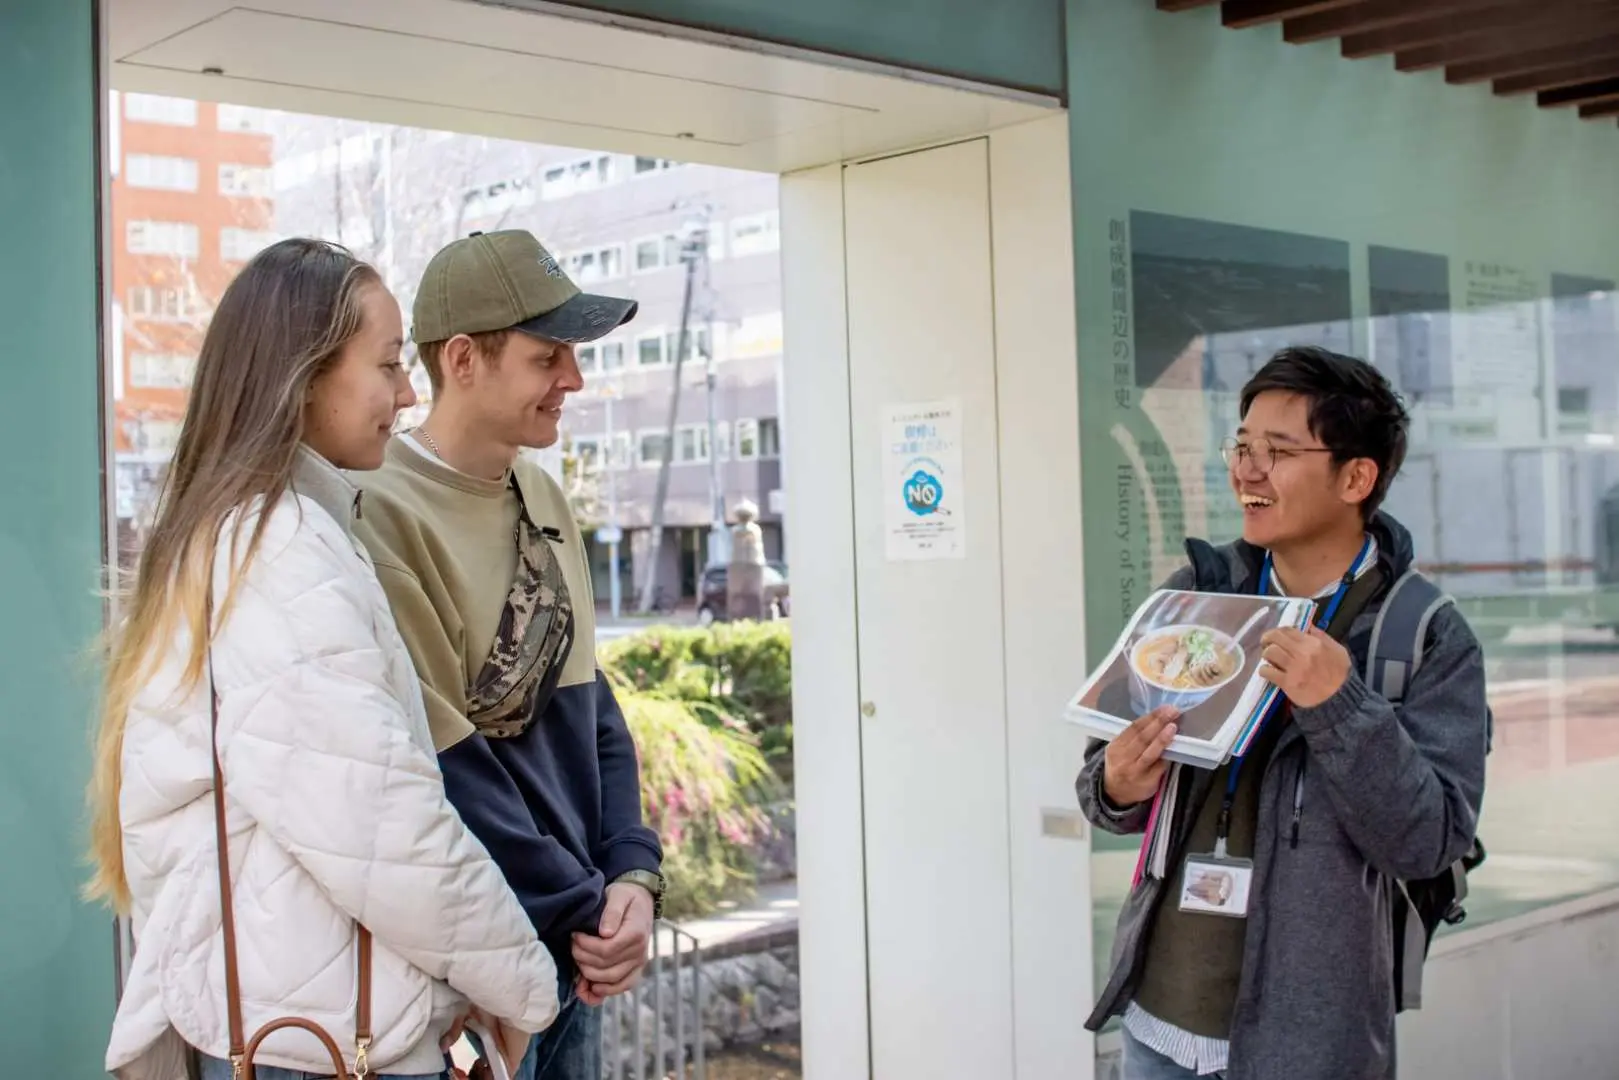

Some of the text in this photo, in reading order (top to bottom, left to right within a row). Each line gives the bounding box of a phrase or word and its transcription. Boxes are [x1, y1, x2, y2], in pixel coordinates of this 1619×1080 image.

[907, 484, 937, 505] NO
[1115, 464, 1136, 542] History
[1119, 550, 1136, 571] of
